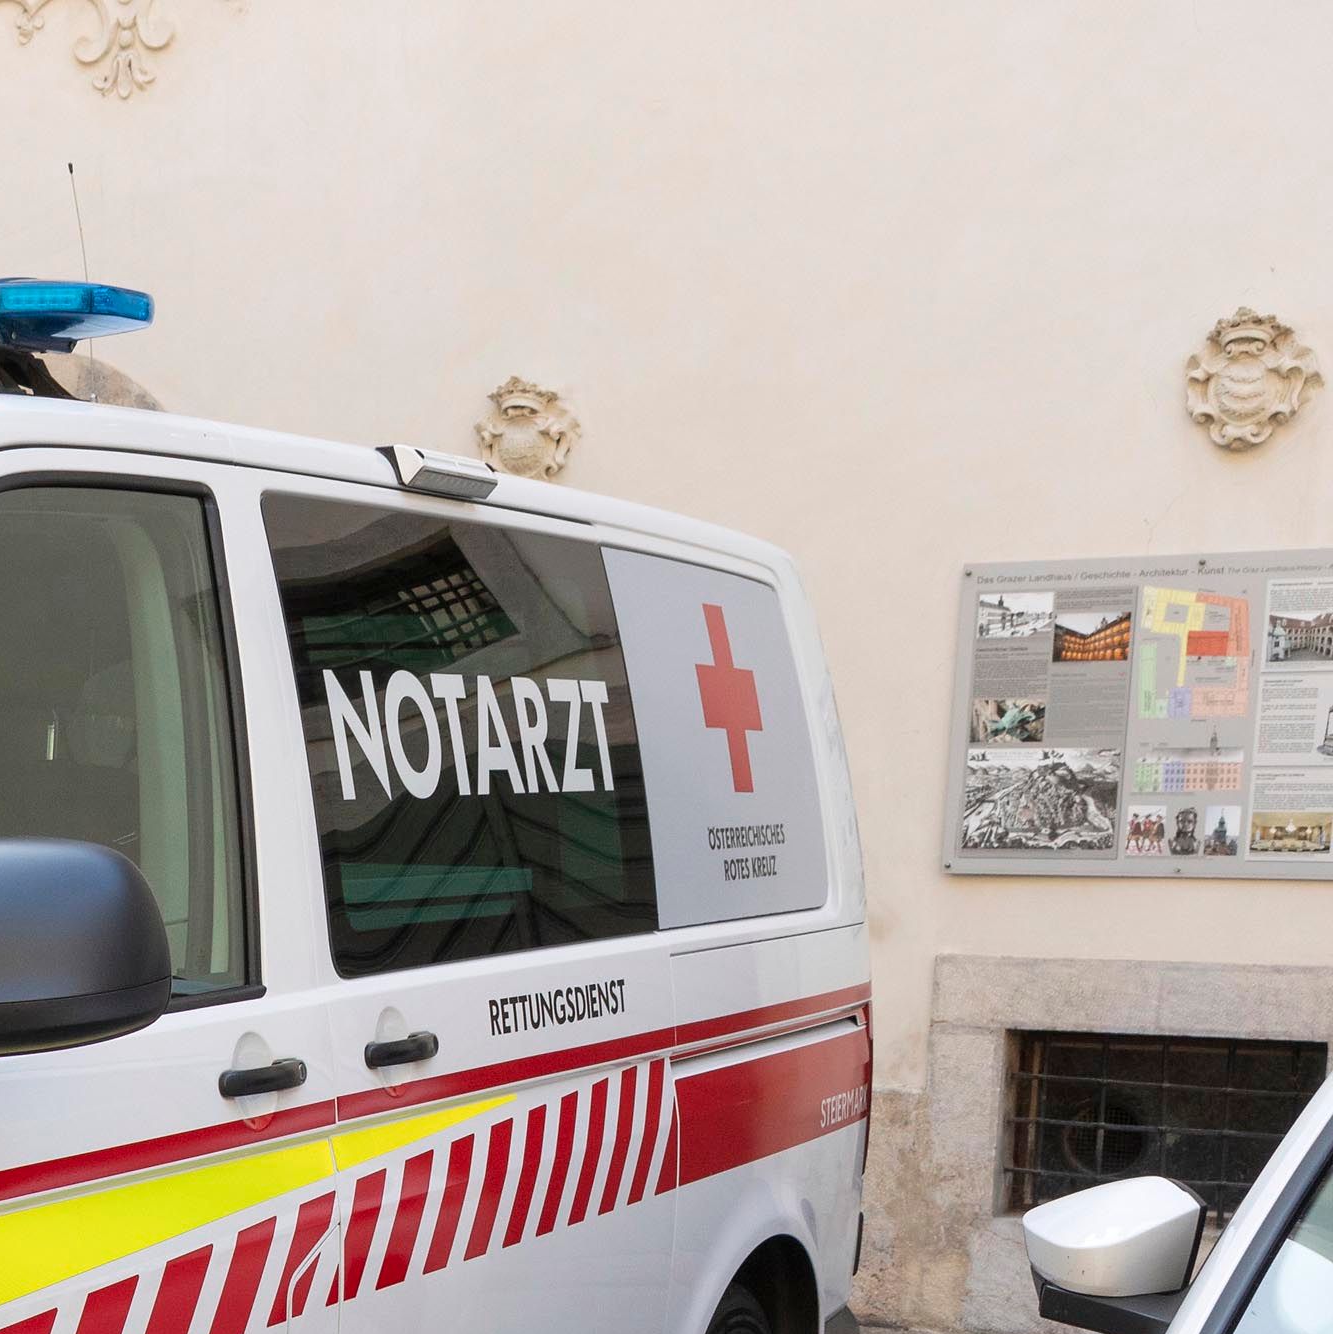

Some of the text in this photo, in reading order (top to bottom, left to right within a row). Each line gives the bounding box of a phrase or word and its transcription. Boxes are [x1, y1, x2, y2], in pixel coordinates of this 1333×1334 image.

[976, 575, 994, 585] Das
[996, 574, 1027, 584] Grazer
[1028, 571, 1073, 583] Landhaus
[1080, 569, 1132, 581] Geschichte
[1138, 567, 1189, 578] Architektur
[1197, 565, 1225, 576] Kunst
[322, 669, 615, 801] NOTARZT
[707, 822, 785, 850] ÖSTERREICHISCHES
[723, 855, 778, 881] ROTES KREUZ
[488, 978, 625, 1036] RETTUNGSDIENST
